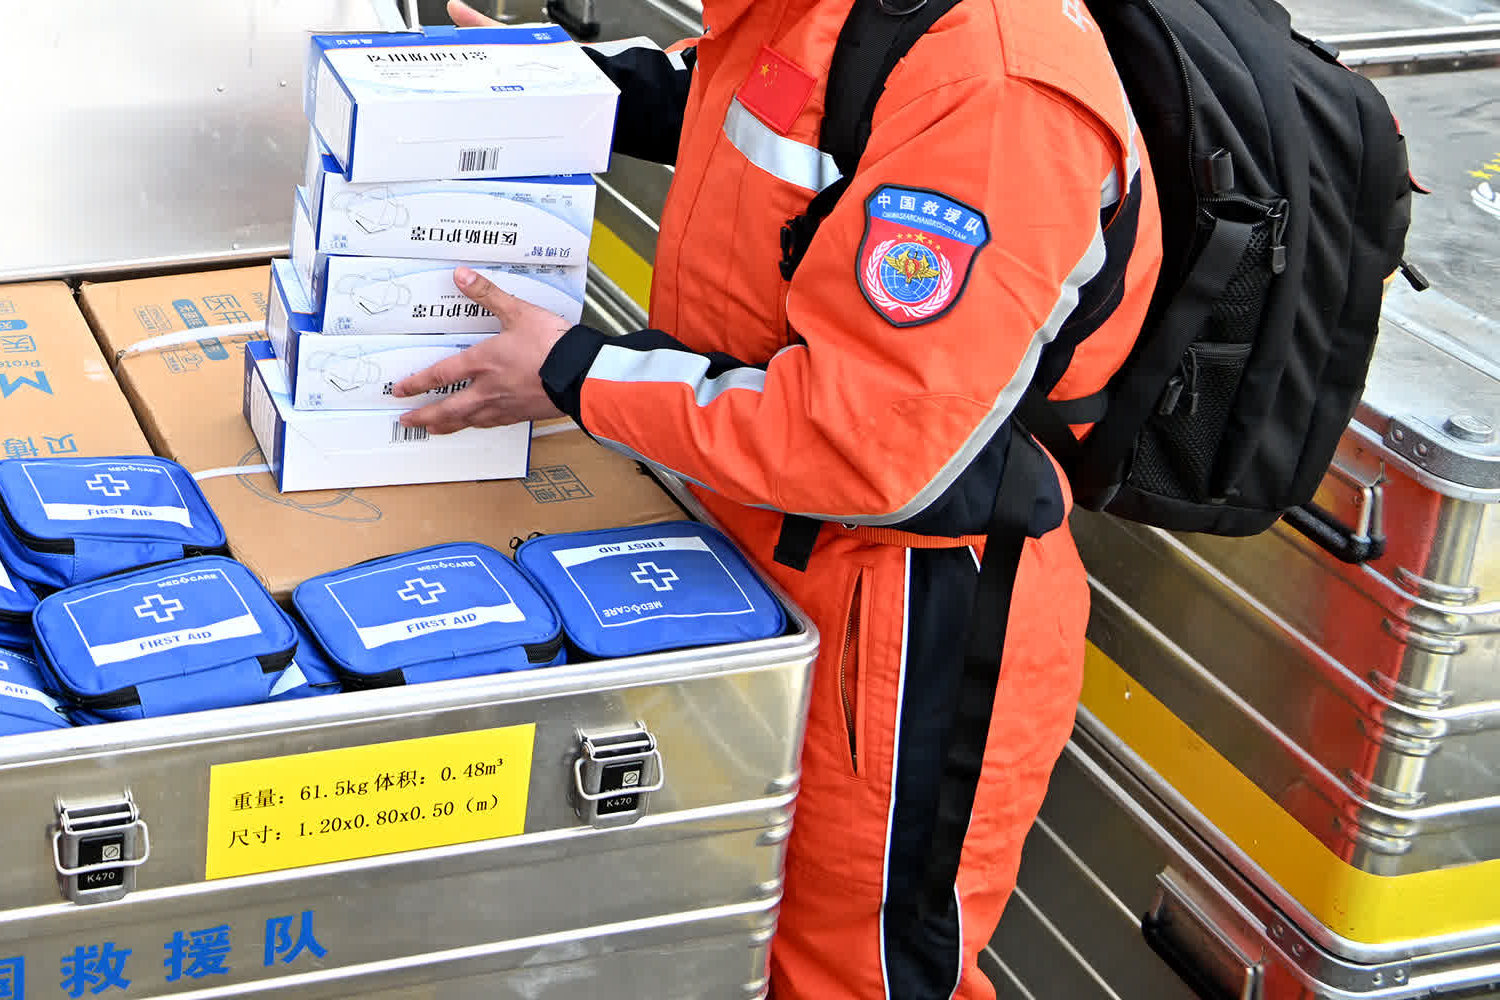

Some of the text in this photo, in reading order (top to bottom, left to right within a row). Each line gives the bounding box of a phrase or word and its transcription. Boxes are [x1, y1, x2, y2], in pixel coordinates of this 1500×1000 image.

[877, 192, 981, 236] 中国救援队
[598, 540, 666, 554] FIRST AID
[406, 612, 477, 633] FIRST AID
[139, 630, 213, 651] FIRST AID
[299, 778, 370, 801] 61.5kg
[87, 871, 116, 883] K470
